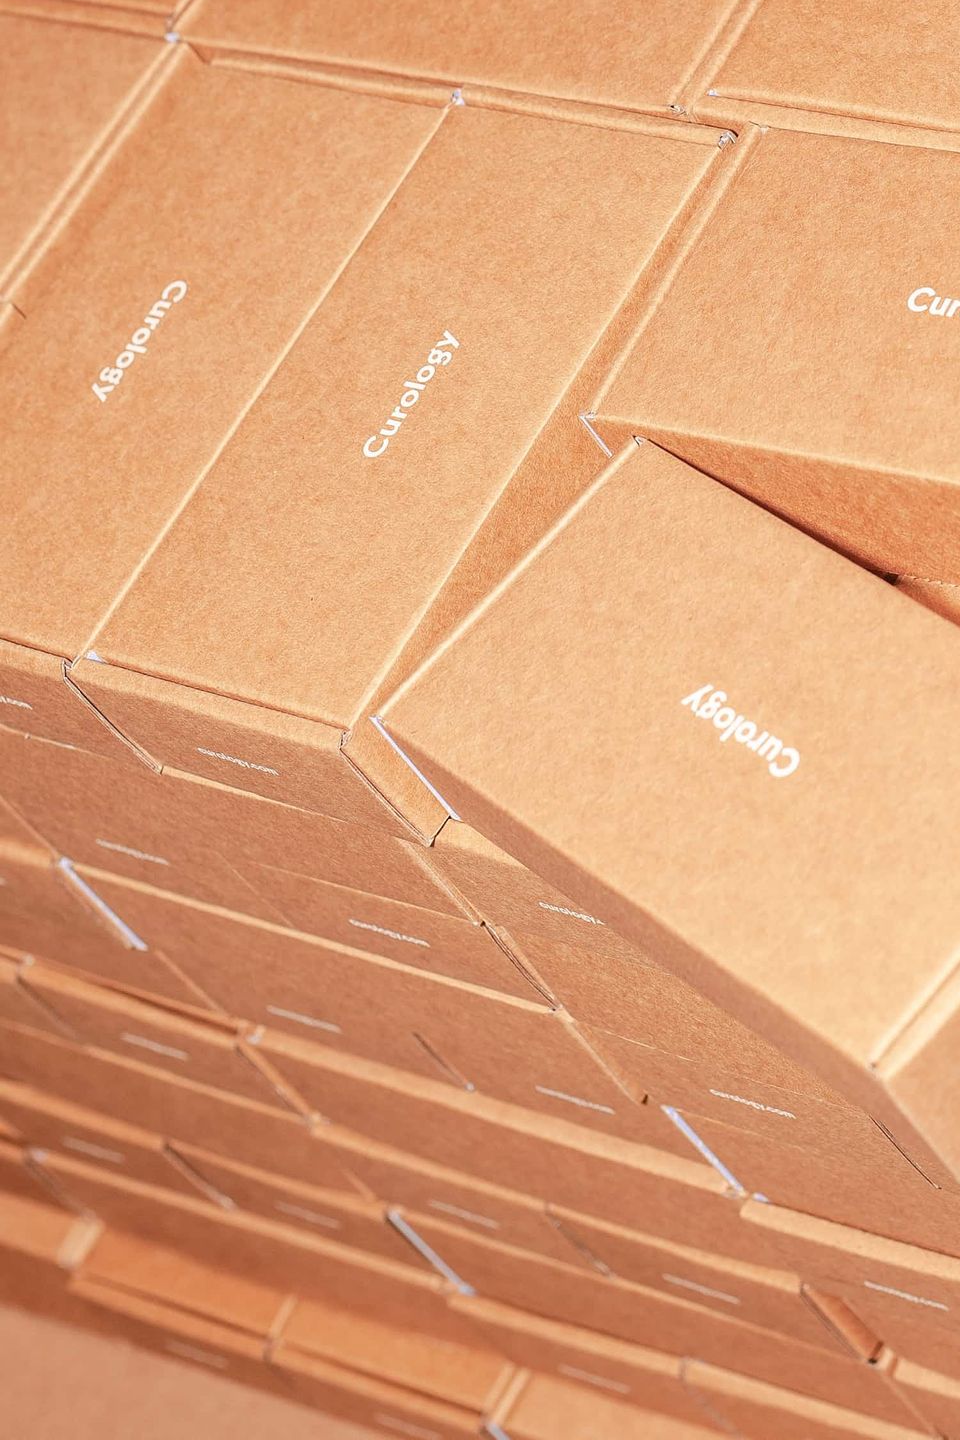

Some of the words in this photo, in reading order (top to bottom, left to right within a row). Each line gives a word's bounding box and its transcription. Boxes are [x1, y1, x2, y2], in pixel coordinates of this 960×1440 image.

[91, 280, 188, 403] Curology
[362, 330, 460, 458] Curology
[680, 683, 801, 778] Curology
